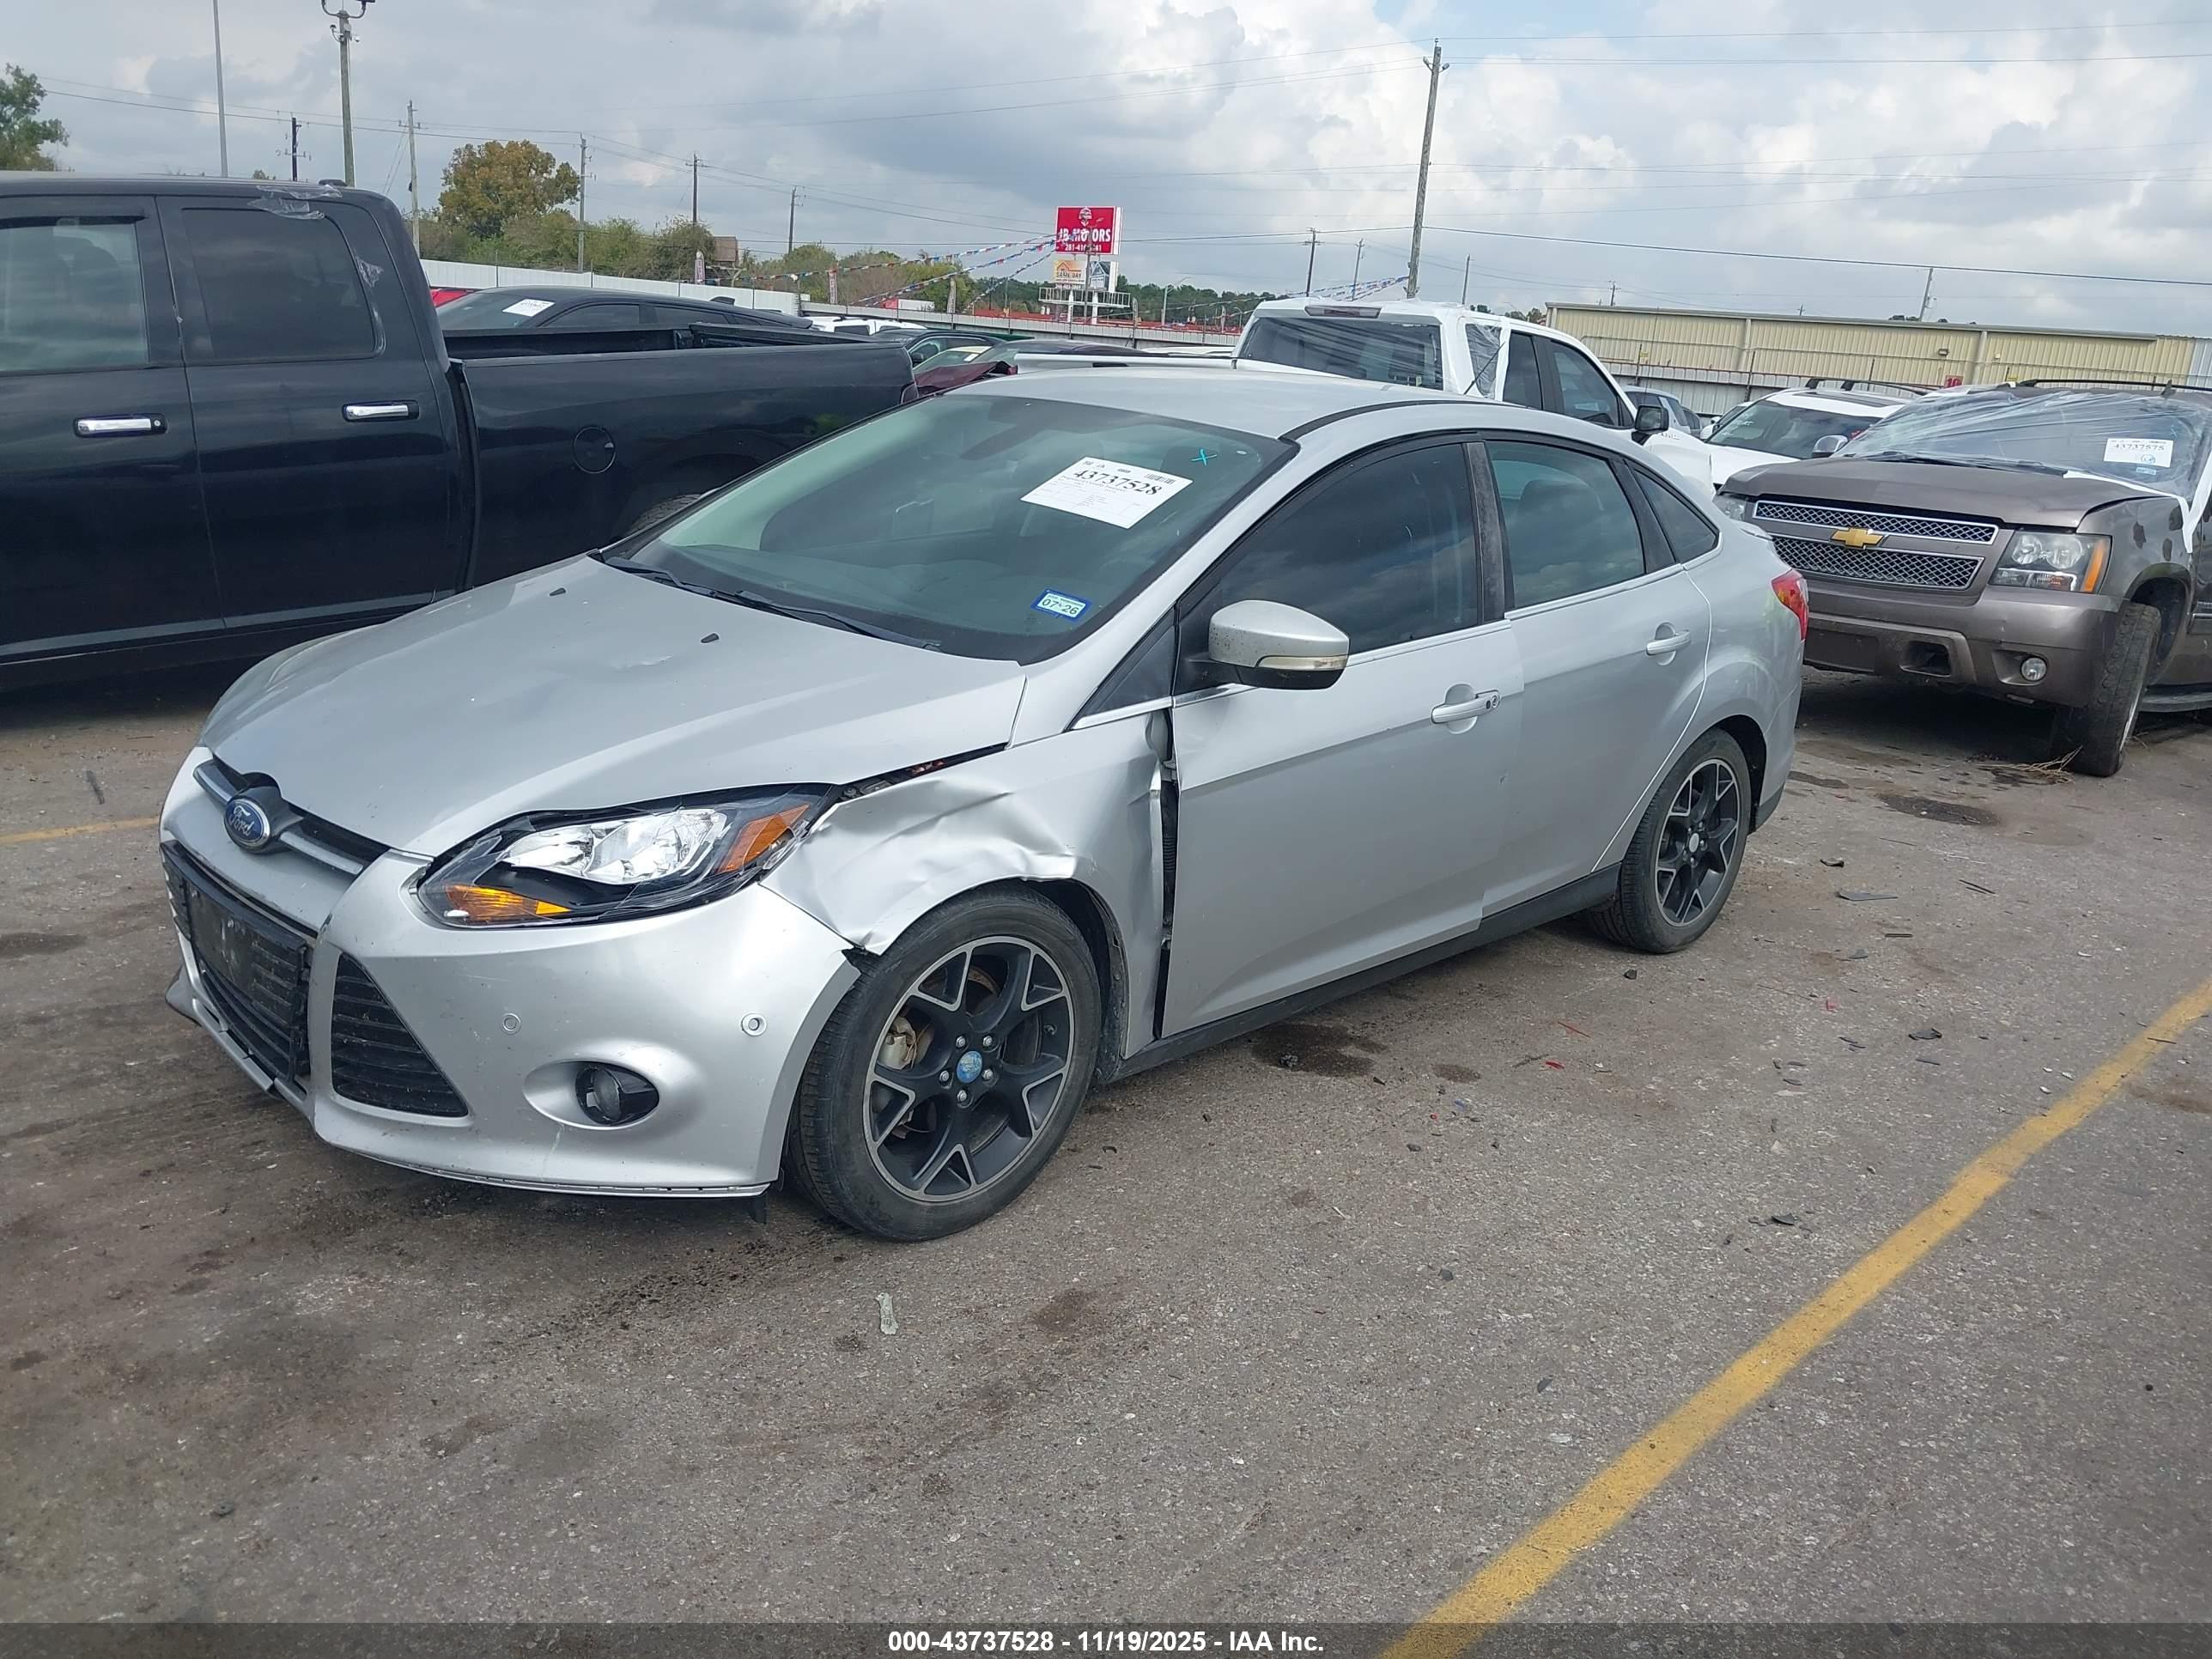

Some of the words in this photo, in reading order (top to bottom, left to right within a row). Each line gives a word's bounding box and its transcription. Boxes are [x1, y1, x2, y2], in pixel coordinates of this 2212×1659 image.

[1073, 470, 1163, 495] 43737528
[1042, 599, 1060, 608] 07
[1061, 605, 1079, 615] 26
[229, 805, 255, 836] Ford
